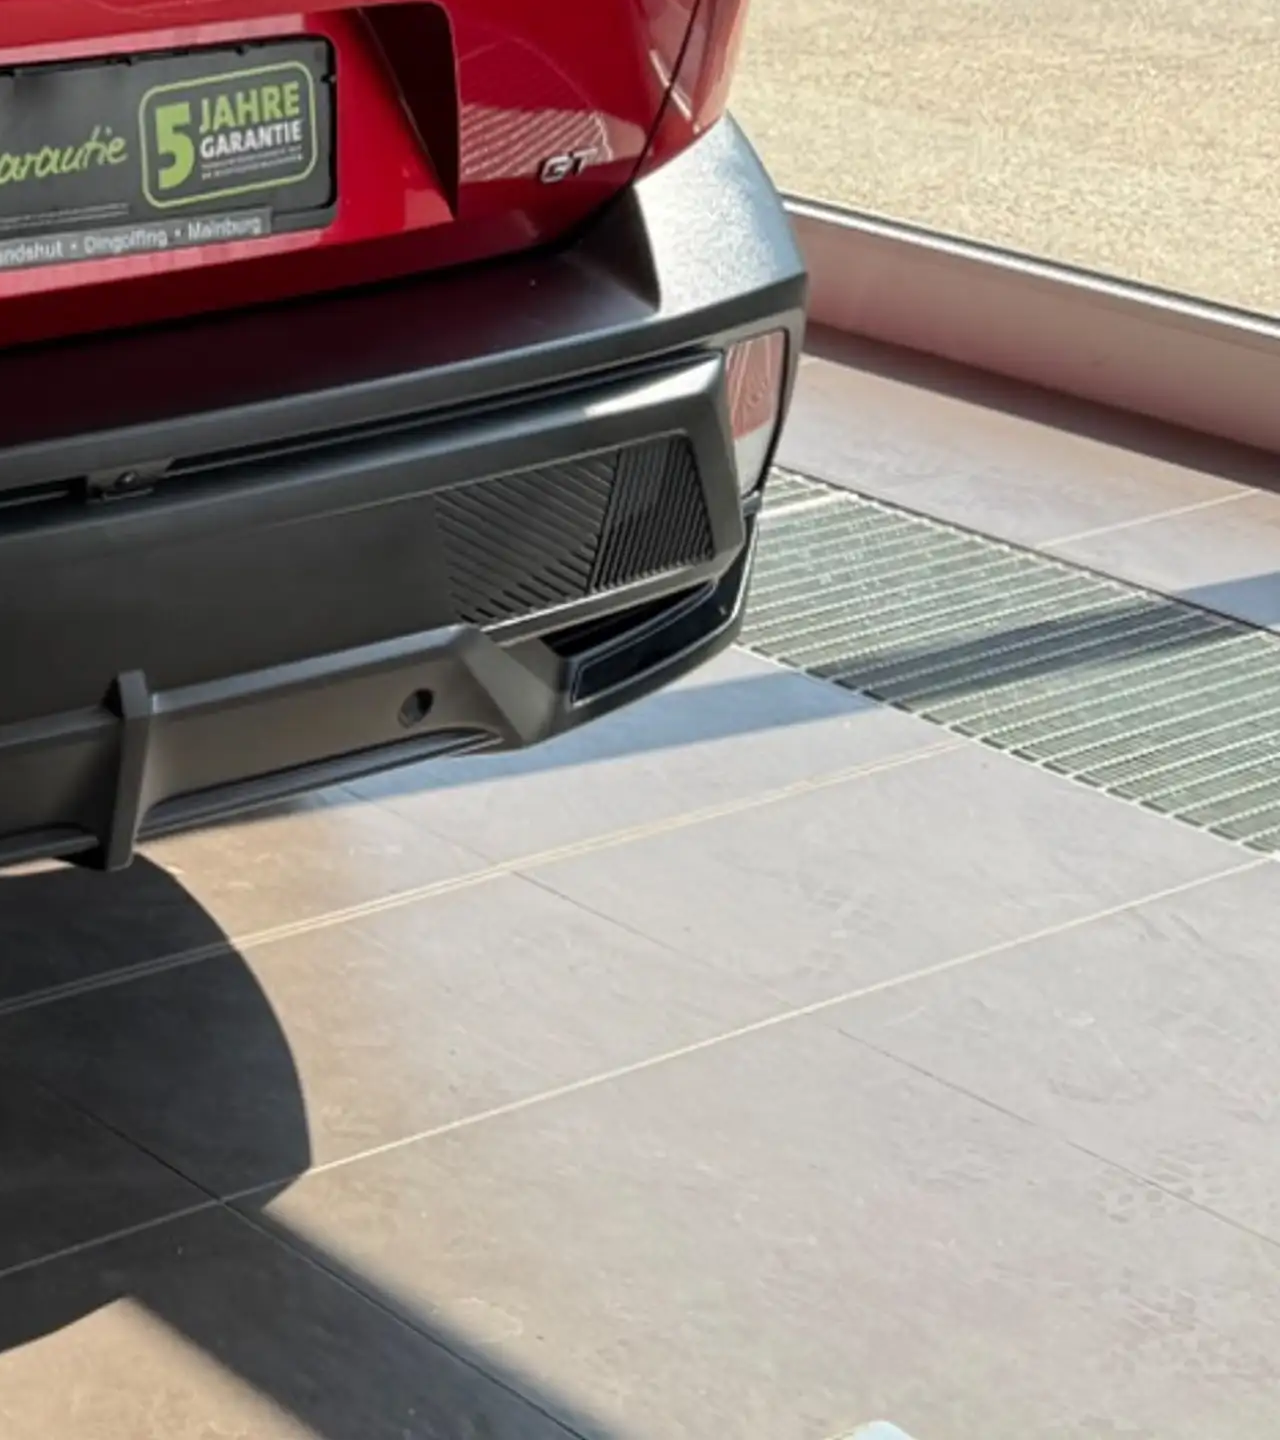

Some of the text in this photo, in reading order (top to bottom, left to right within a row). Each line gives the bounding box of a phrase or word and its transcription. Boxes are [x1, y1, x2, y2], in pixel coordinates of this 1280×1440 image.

[154, 101, 196, 191] 5
[199, 81, 301, 134] JAHRE
[200, 118, 303, 159] GARANTIE
[541, 147, 597, 184] GT
[83, 222, 168, 255] Dingolfing
[188, 214, 262, 240] Mainburg
